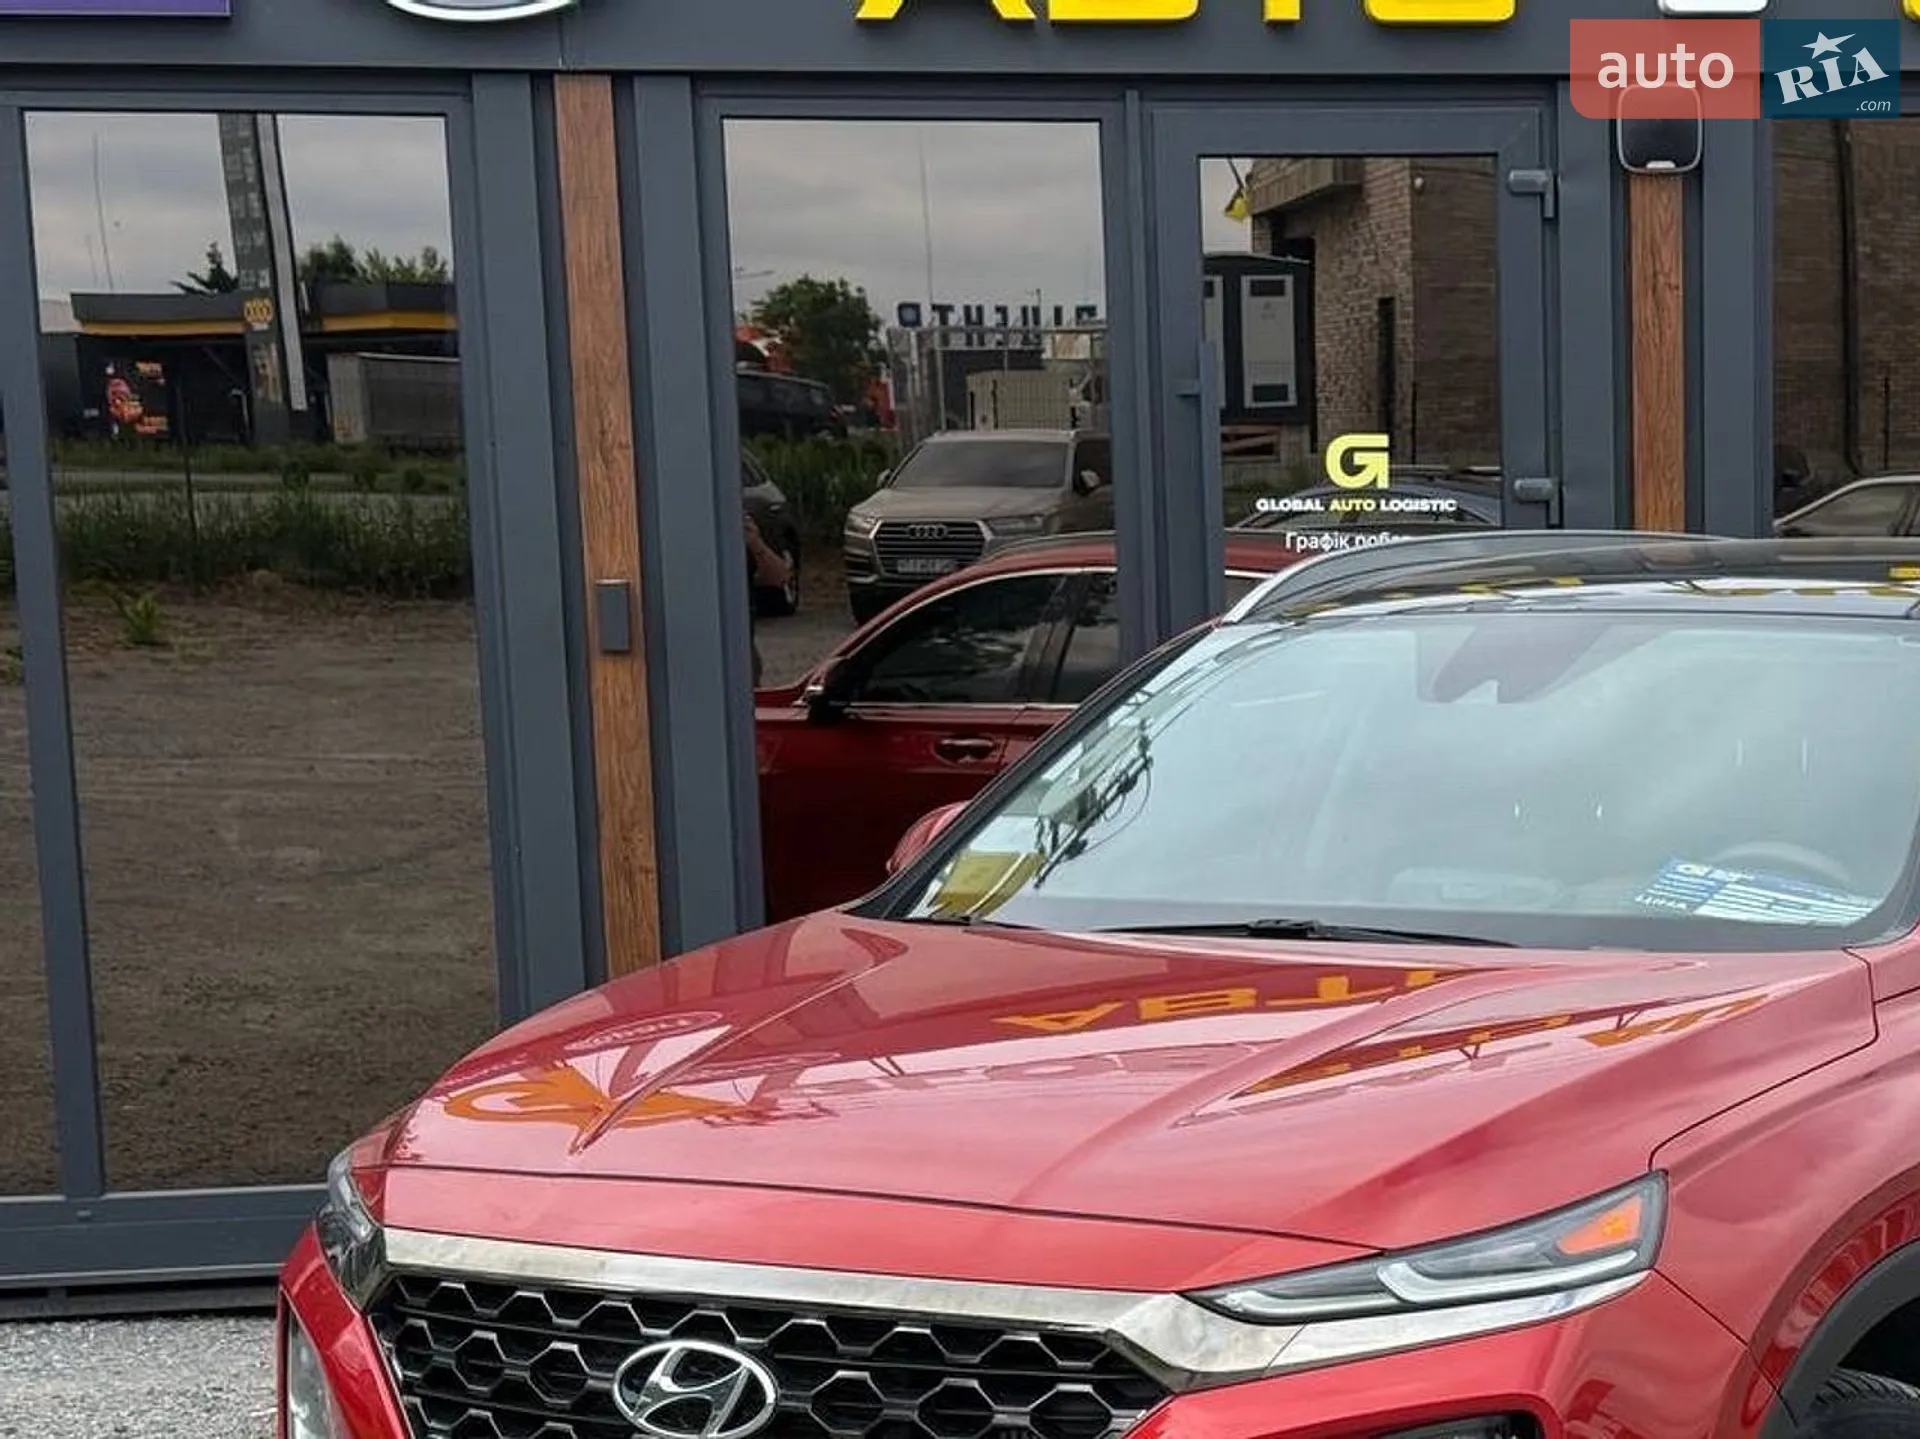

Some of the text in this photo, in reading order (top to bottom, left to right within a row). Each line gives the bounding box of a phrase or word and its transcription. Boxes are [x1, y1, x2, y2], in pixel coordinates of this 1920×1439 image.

[1256, 498, 1458, 512] GLOBAL AUTO LOGISTIC
[1285, 531, 1350, 552] Графік
